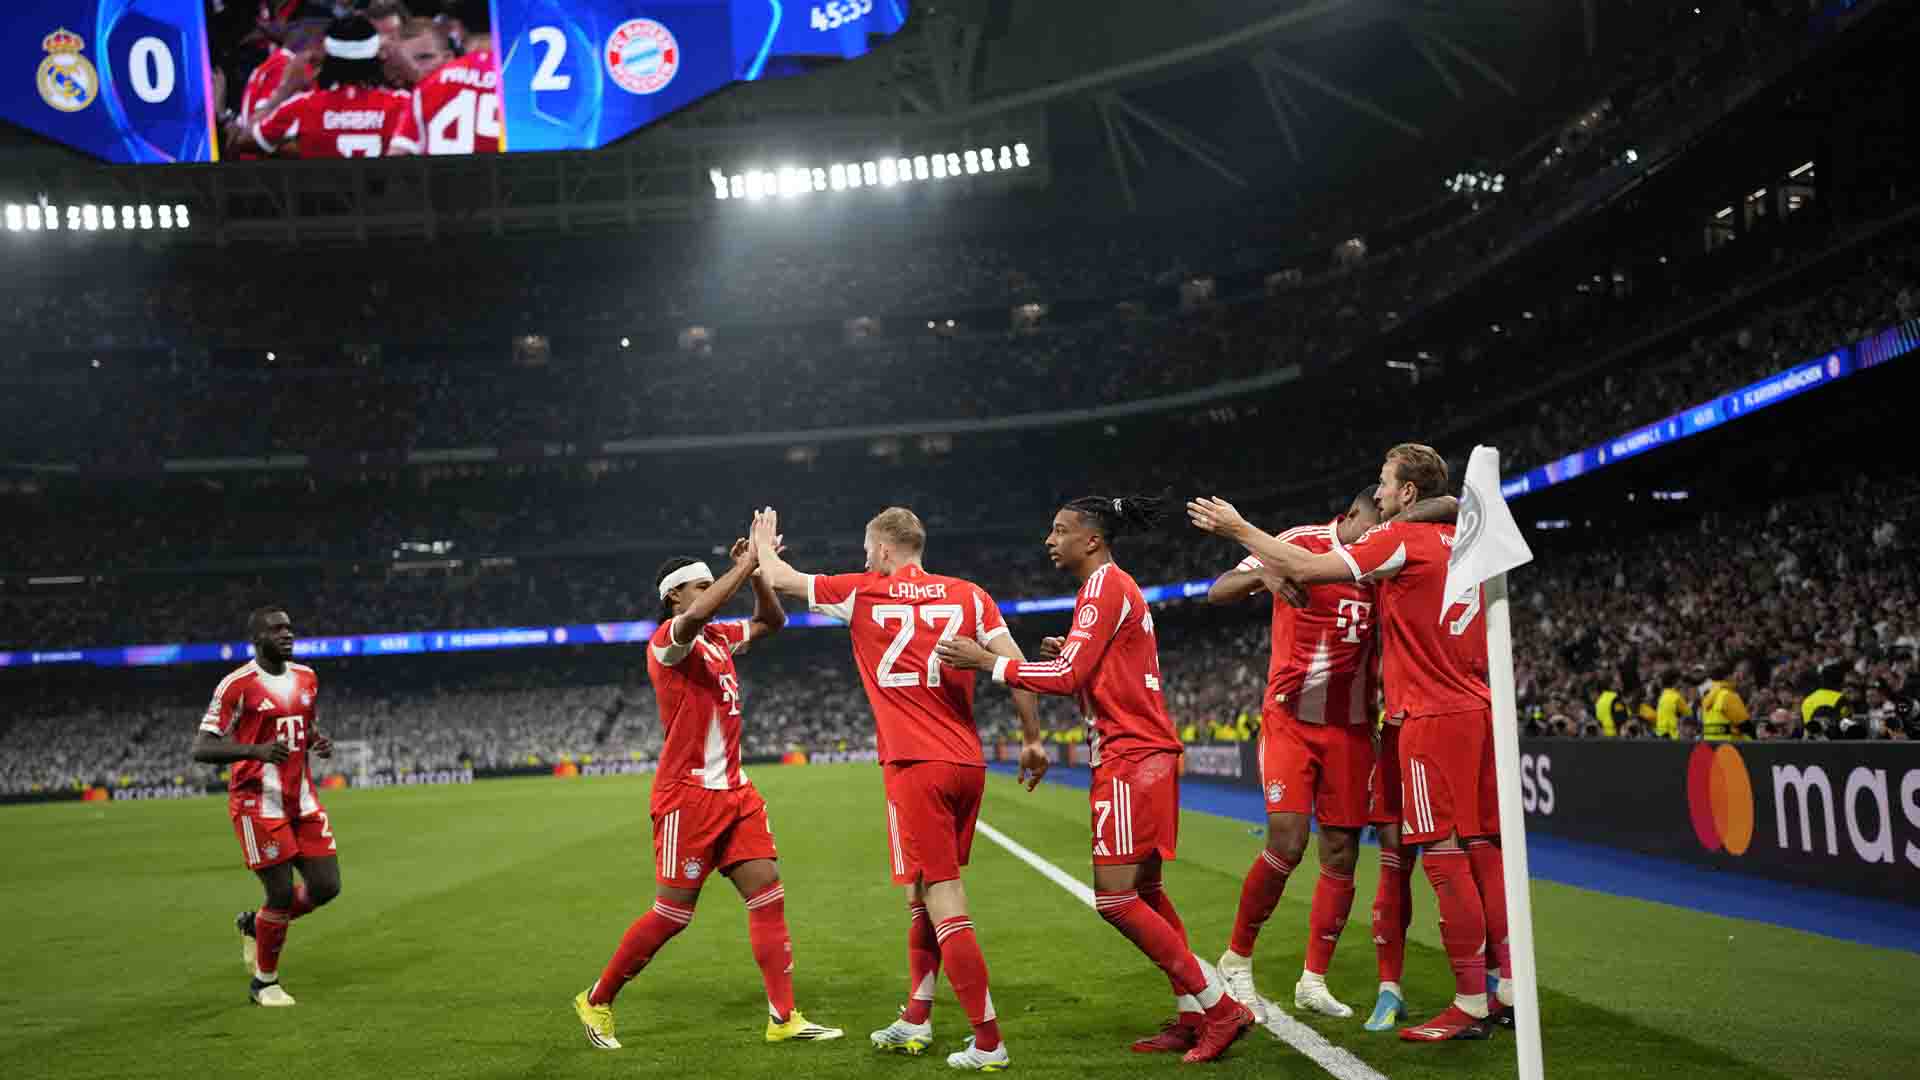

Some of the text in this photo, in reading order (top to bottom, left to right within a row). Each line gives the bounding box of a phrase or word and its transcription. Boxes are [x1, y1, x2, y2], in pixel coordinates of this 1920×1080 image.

[129, 37, 175, 103] 0
[529, 27, 571, 91] 2
[888, 583, 947, 599] LAIMER
[872, 604, 964, 688] 27
[1095, 801, 1112, 839] 7
